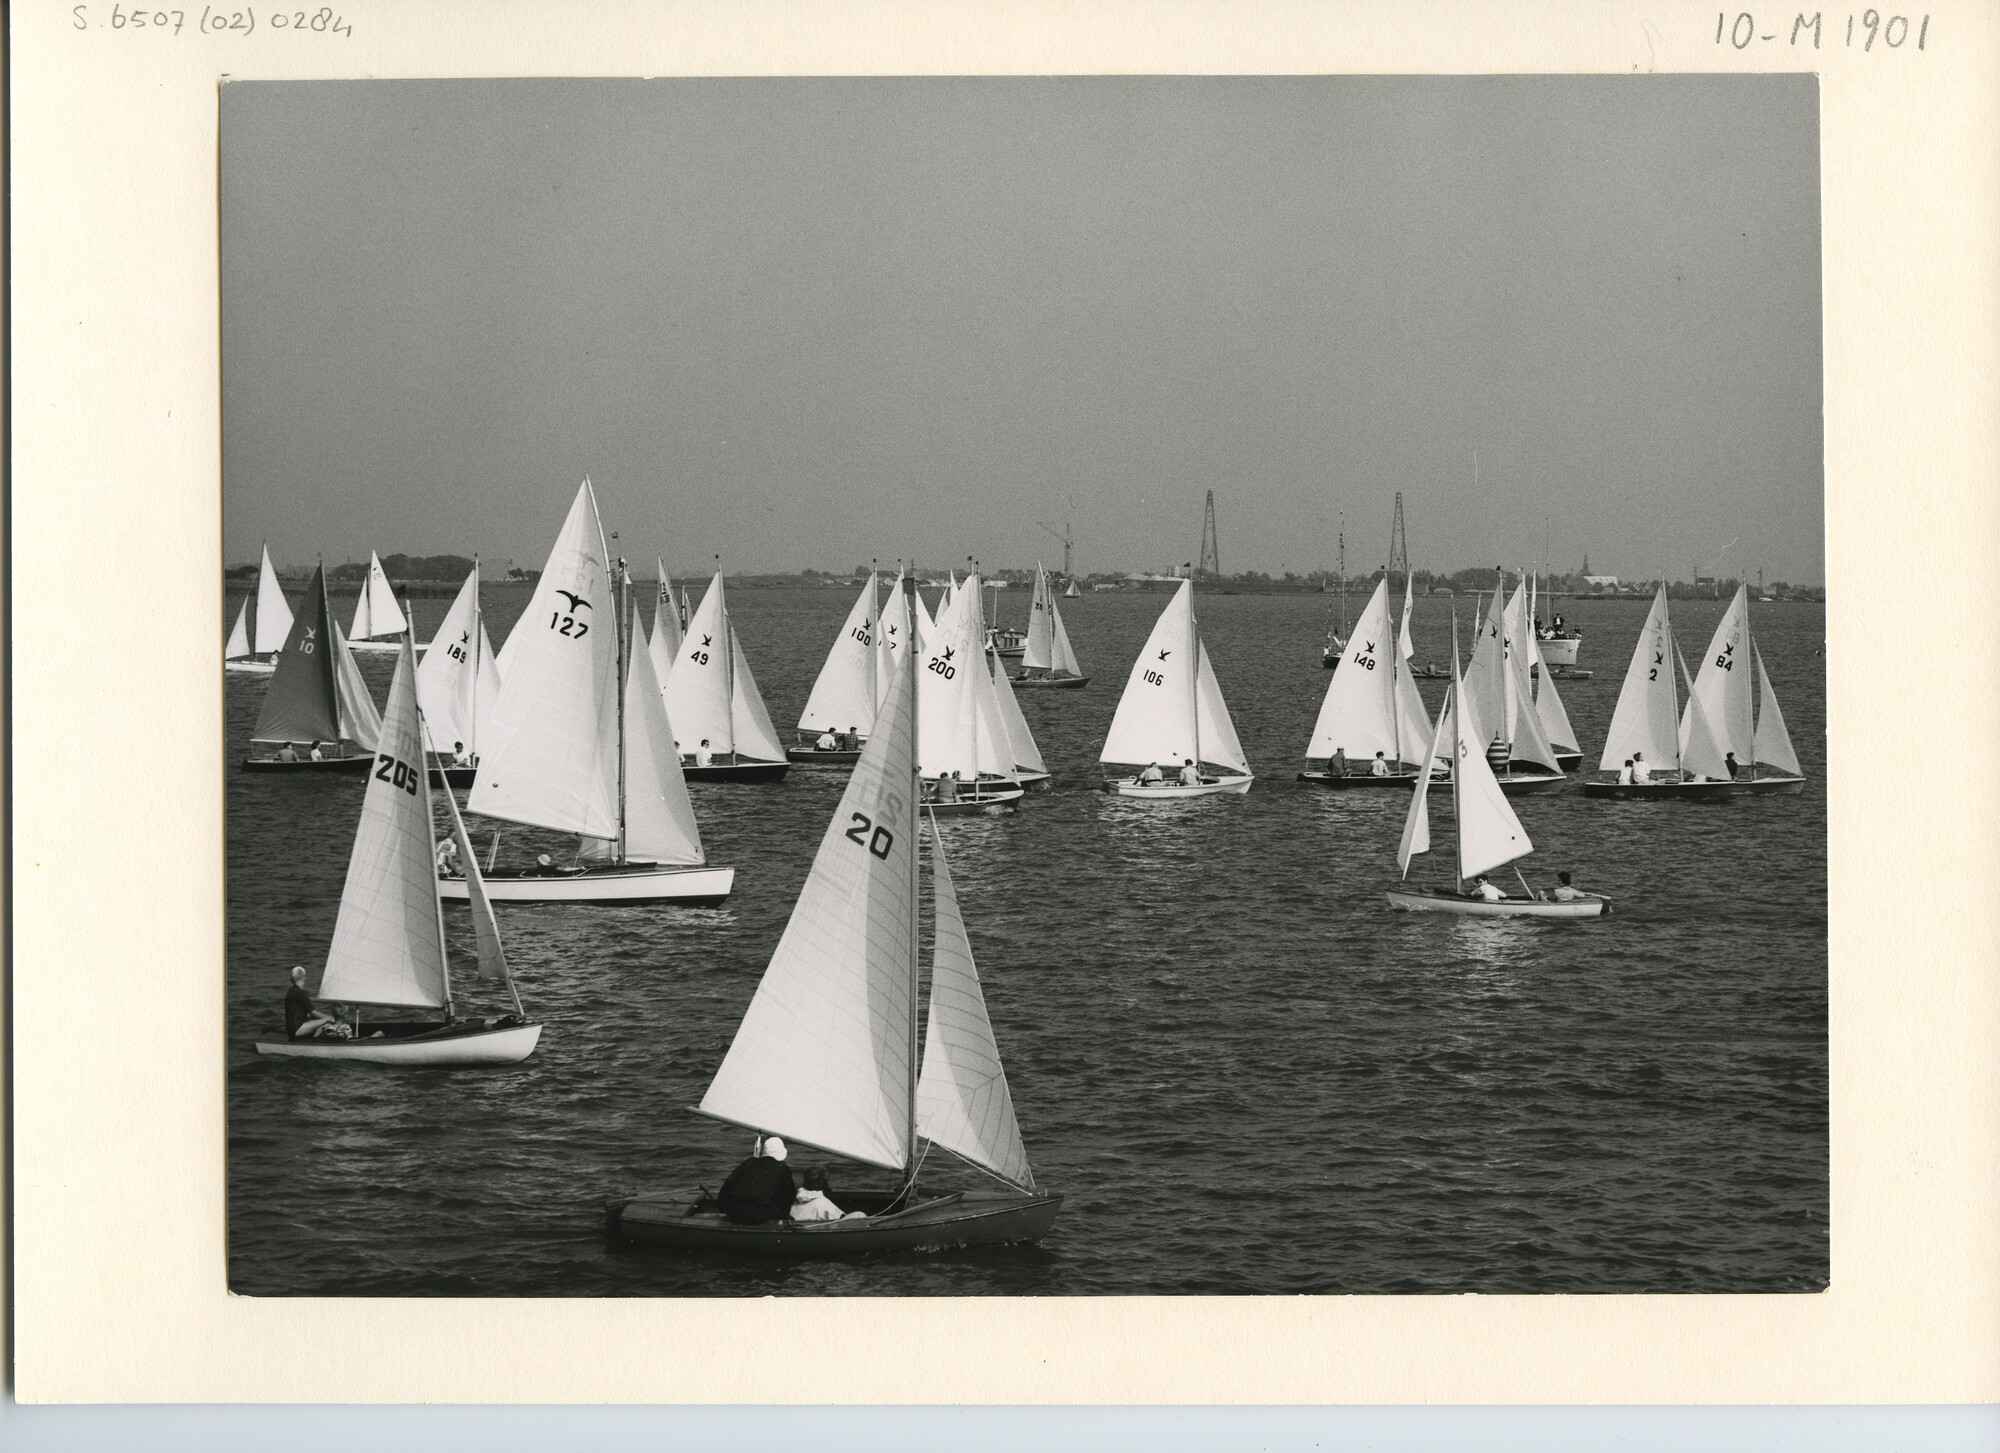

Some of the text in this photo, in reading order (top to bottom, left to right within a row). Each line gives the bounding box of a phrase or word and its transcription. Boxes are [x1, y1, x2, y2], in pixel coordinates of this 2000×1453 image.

[200, 5, 255, 36] (02)
[271, 7, 352, 37] 0284
[1846, 8, 1930, 52] 1901
[550, 612, 588, 640] 127
[851, 627, 871, 646] 100
[299, 640, 314, 654] 10
[447, 644, 467, 664] 189
[690, 650, 709, 665] 49
[1354, 652, 1376, 671] 148
[1716, 655, 1733, 672] 84
[928, 656, 955, 680] 200
[1143, 669, 1164, 686] 106
[1649, 668, 1658, 682] 2
[375, 753, 419, 797] 205
[845, 812, 894, 861] 20
